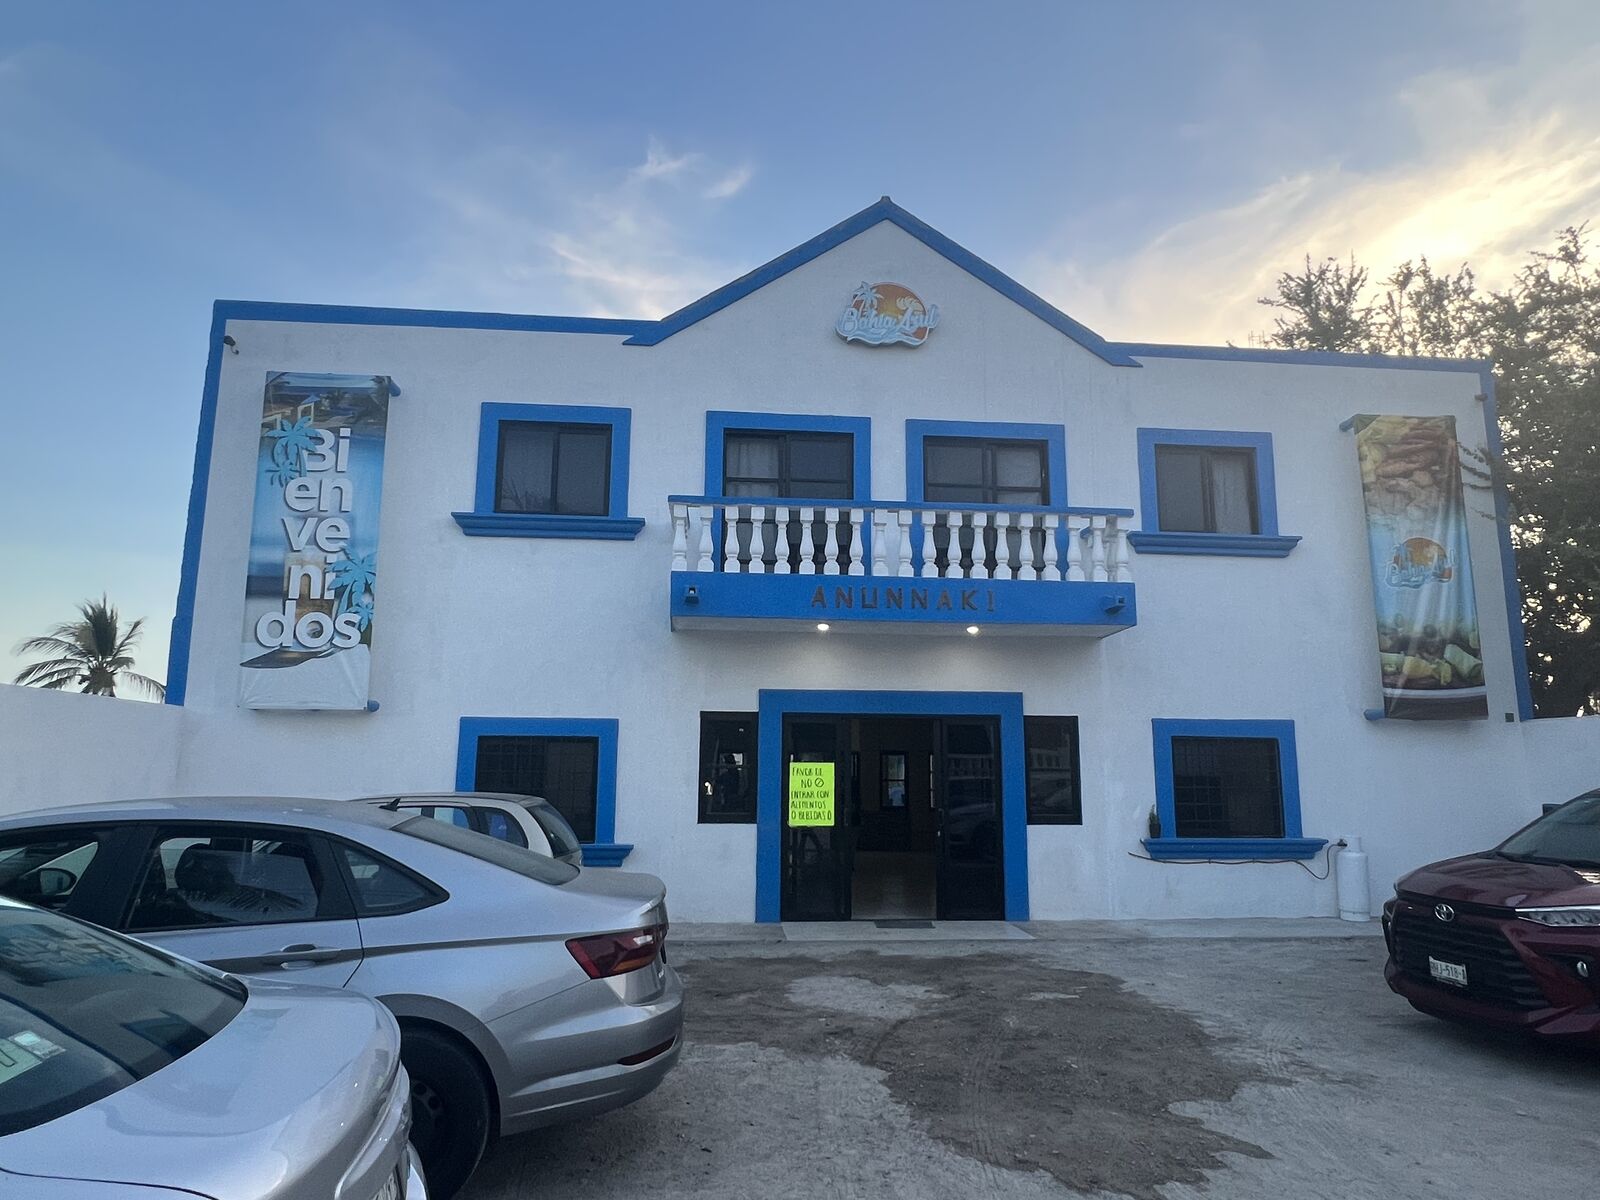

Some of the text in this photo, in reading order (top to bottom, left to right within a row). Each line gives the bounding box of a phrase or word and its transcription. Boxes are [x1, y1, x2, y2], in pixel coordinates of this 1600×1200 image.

[284, 476, 353, 513] en
[281, 516, 351, 553] ve
[287, 554, 337, 600] ni
[811, 586, 995, 612] ANUNNAKI
[255, 600, 362, 649] dos
[791, 790, 829, 799] ENTRAR CON
[800, 778, 812, 788] NO
[790, 800, 826, 809] ALIMENTOS
[798, 810, 826, 820] BEBIDAS
